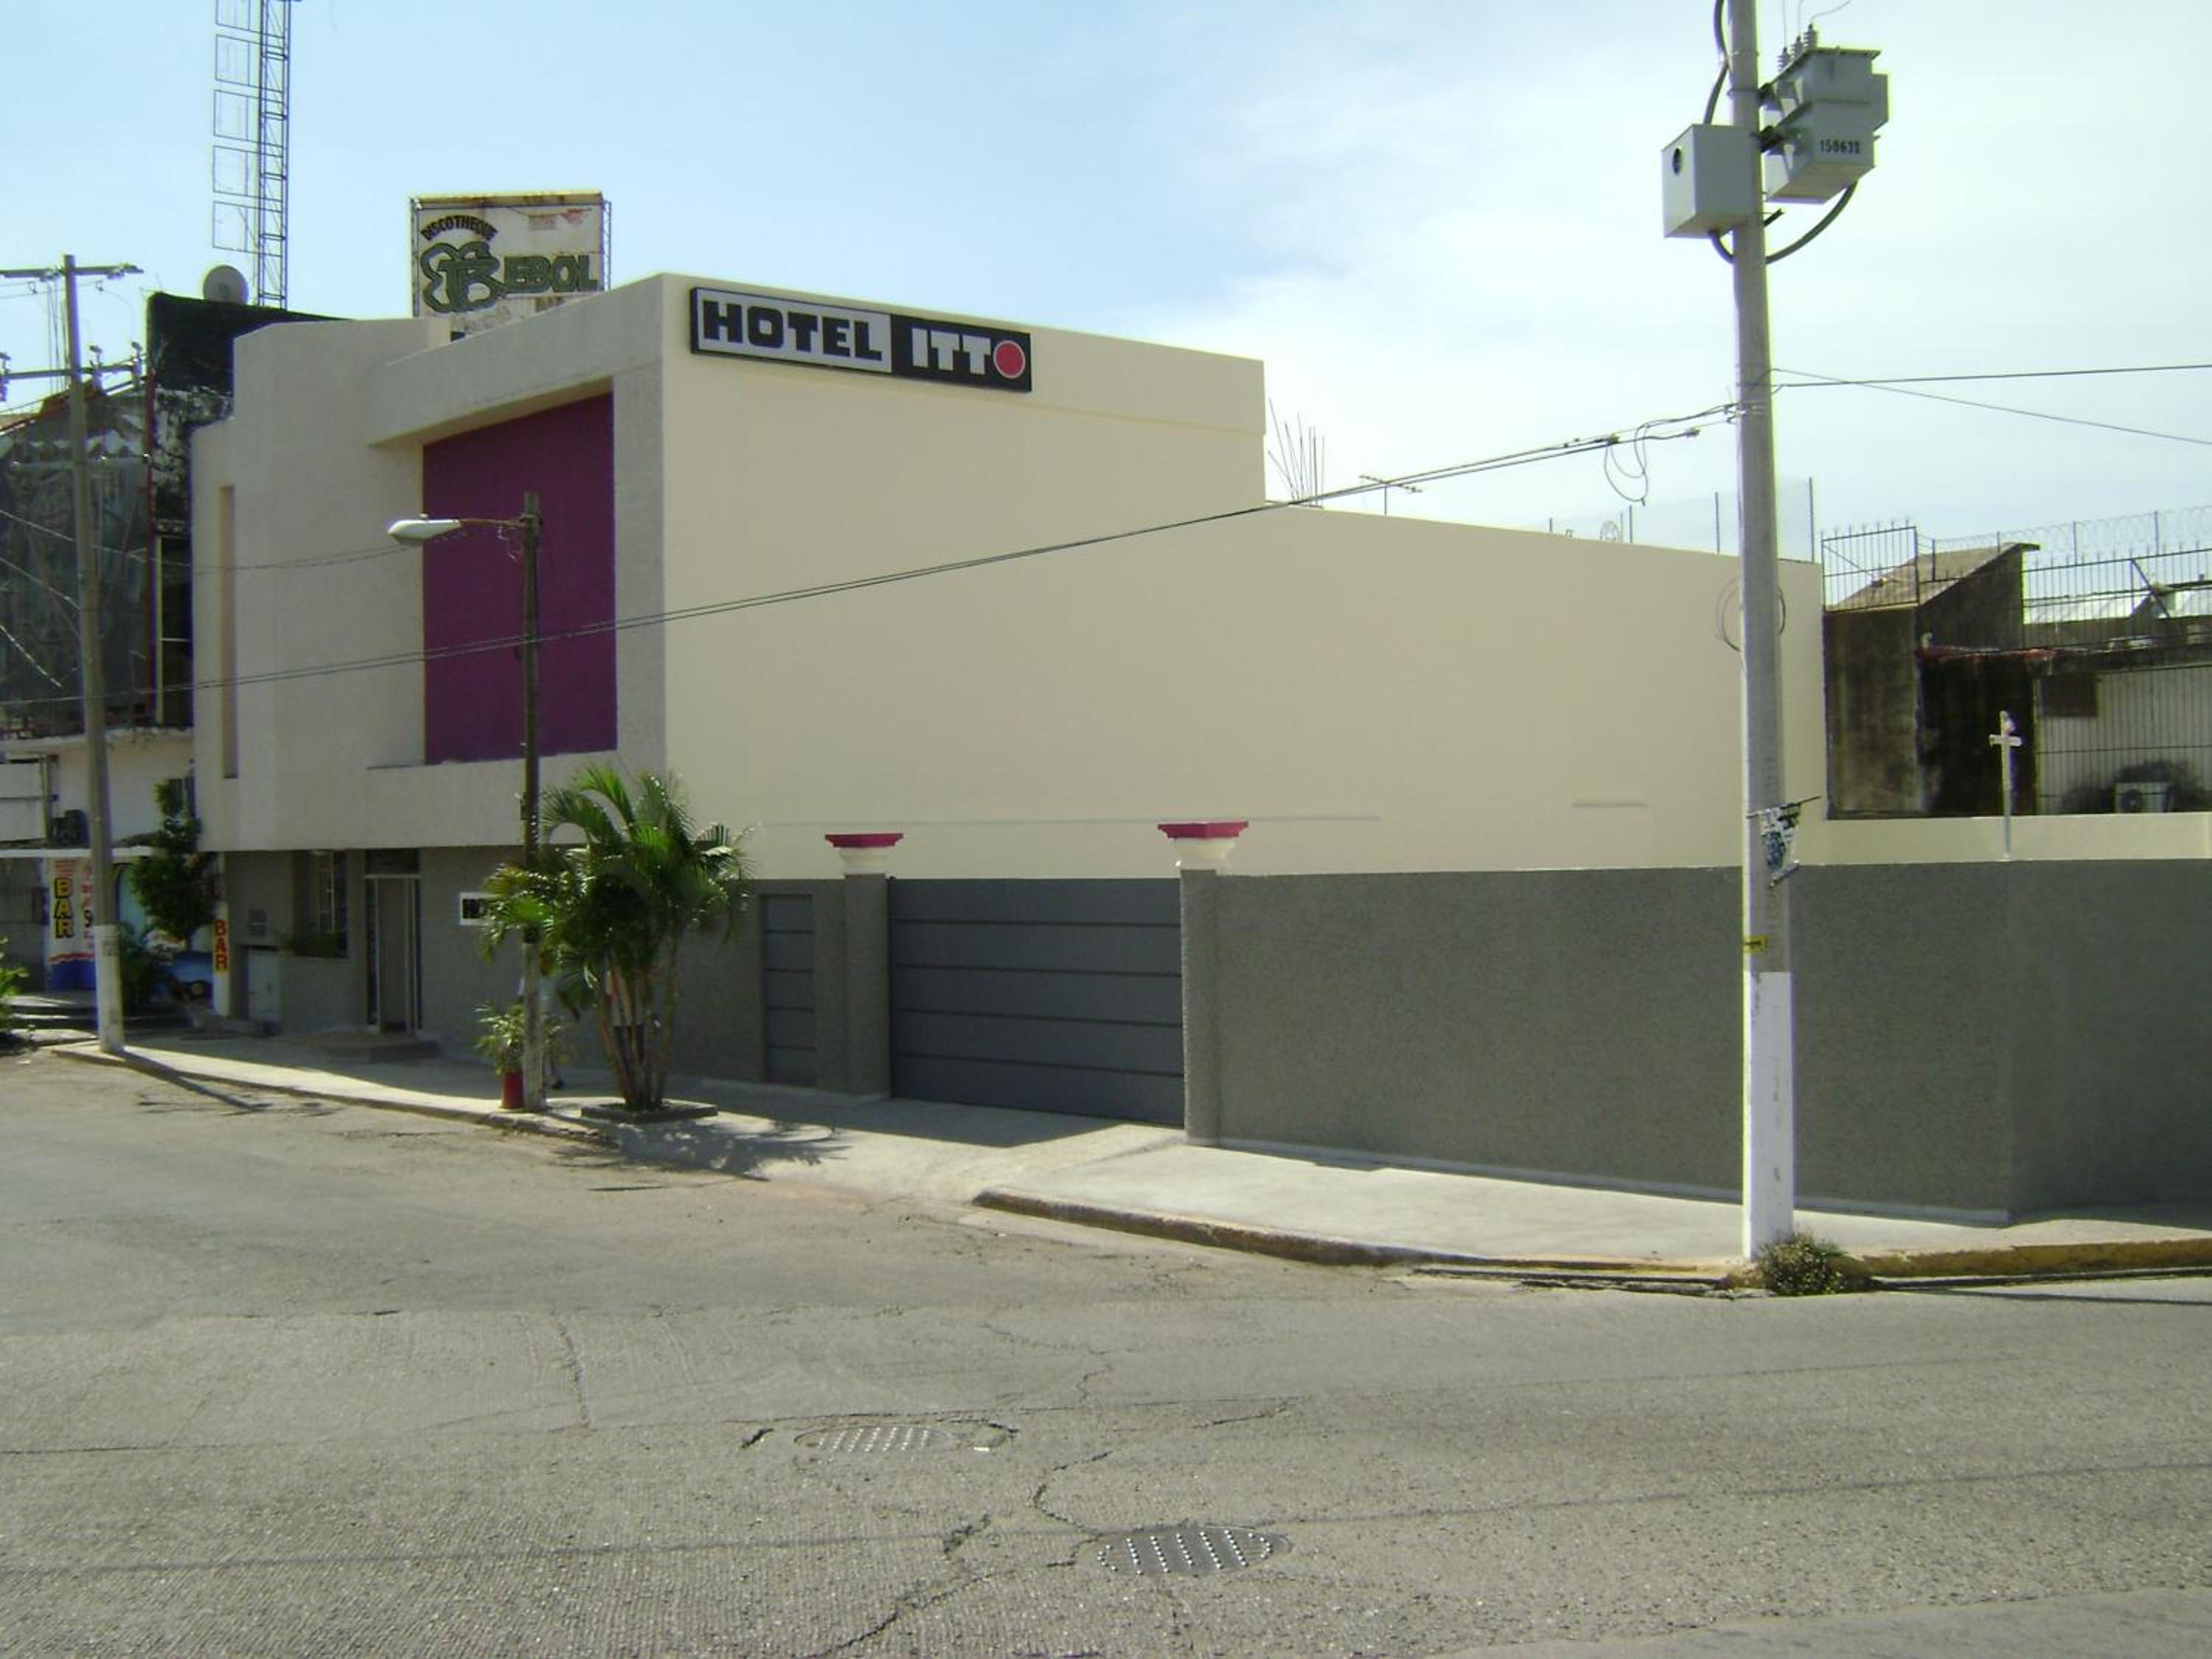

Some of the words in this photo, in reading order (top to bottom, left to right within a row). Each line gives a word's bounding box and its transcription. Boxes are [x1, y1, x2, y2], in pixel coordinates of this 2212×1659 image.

[702, 299, 884, 362] HOTEL
[54, 877, 74, 939] BAR
[214, 919, 229, 971] BAR
